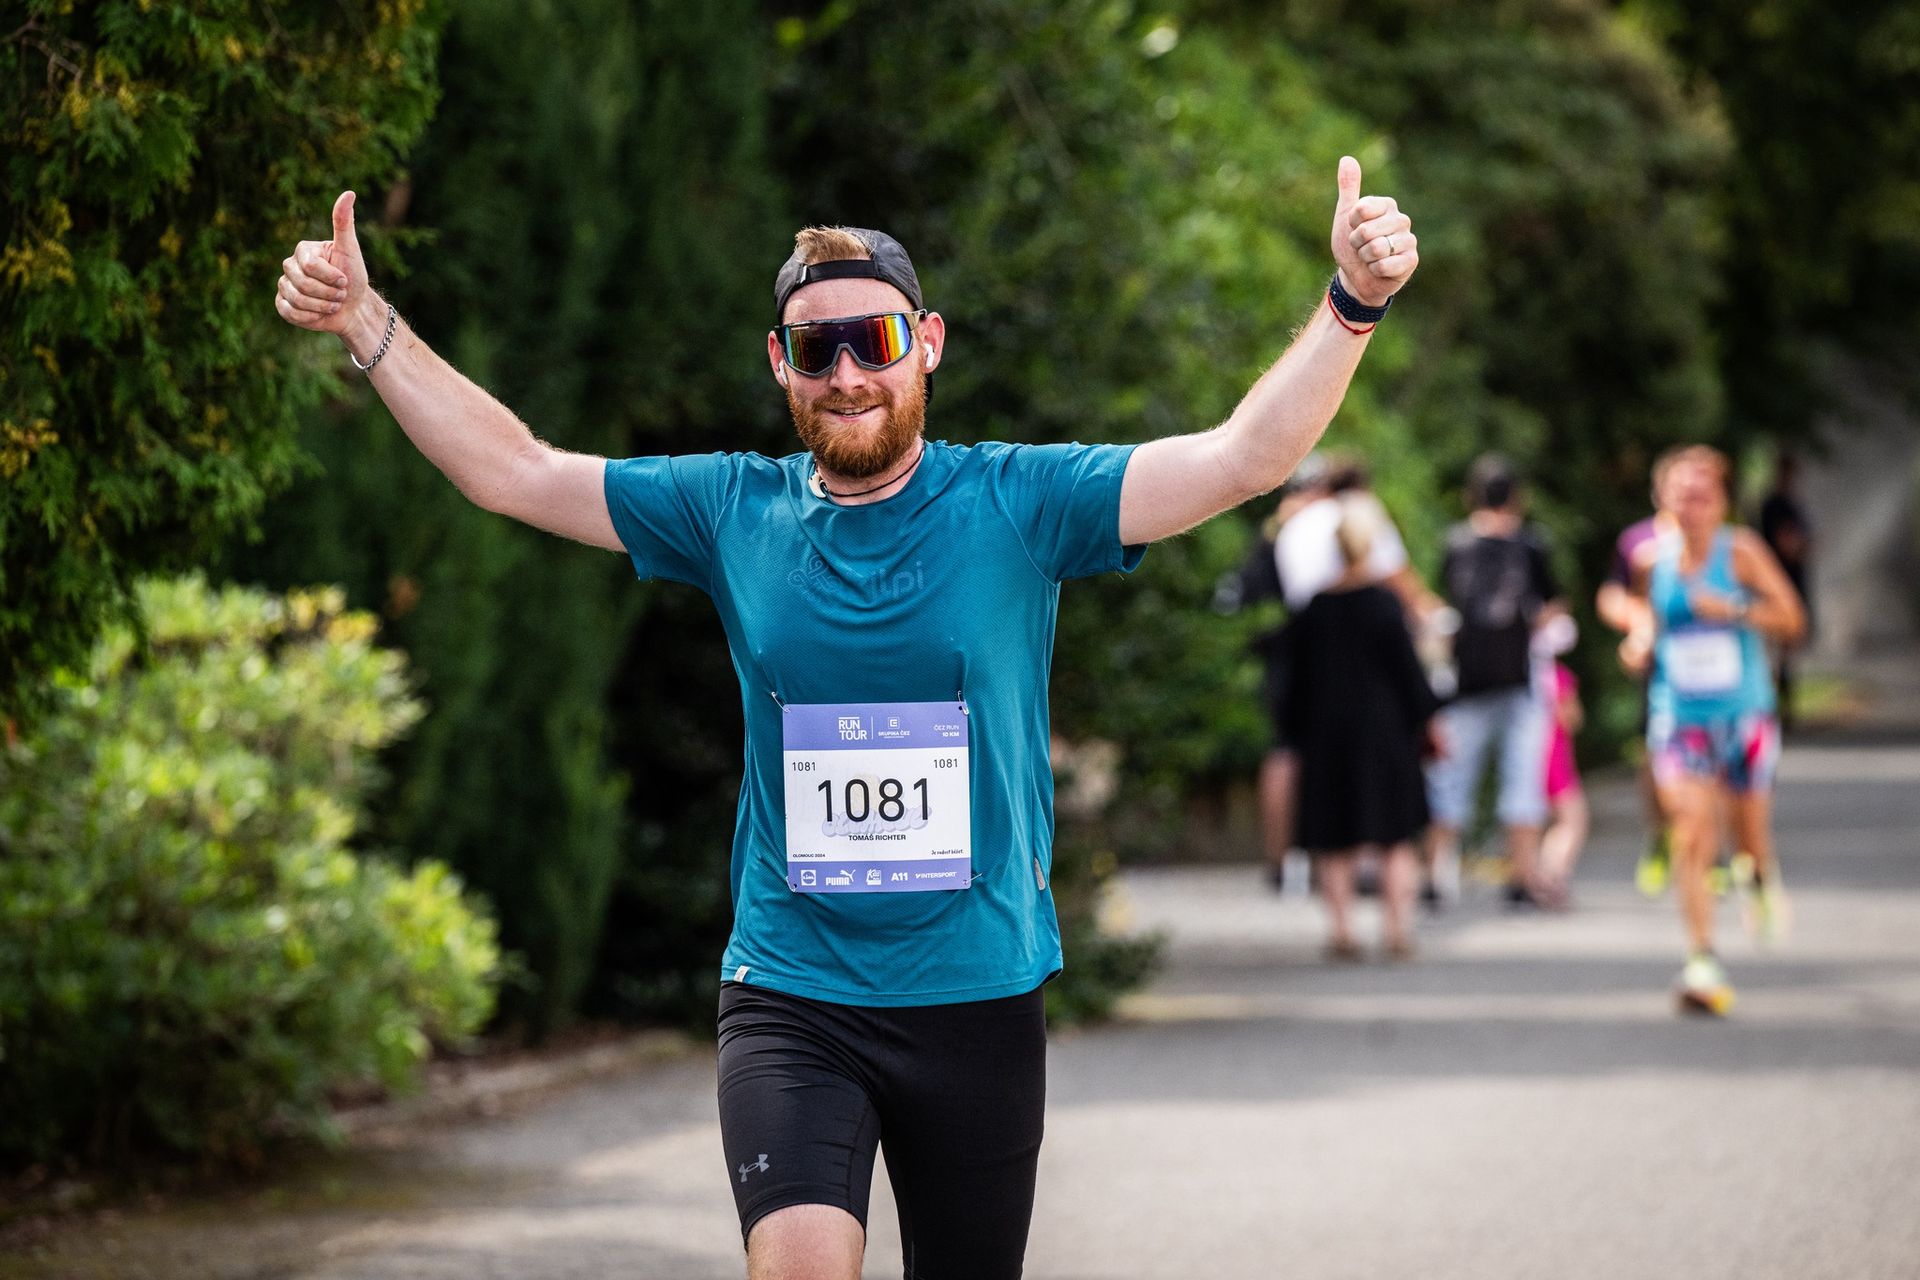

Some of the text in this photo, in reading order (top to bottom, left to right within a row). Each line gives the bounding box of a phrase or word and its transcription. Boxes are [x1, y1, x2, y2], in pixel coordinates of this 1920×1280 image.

[838, 719, 860, 730] RUN
[839, 730, 867, 741] TOUR
[792, 761, 817, 772] 1081
[933, 758, 958, 769] 1081
[818, 778, 929, 823] 1081
[848, 833, 874, 842] TOMÁŠ
[825, 876, 850, 886] PUMA
[891, 872, 909, 882] A11
